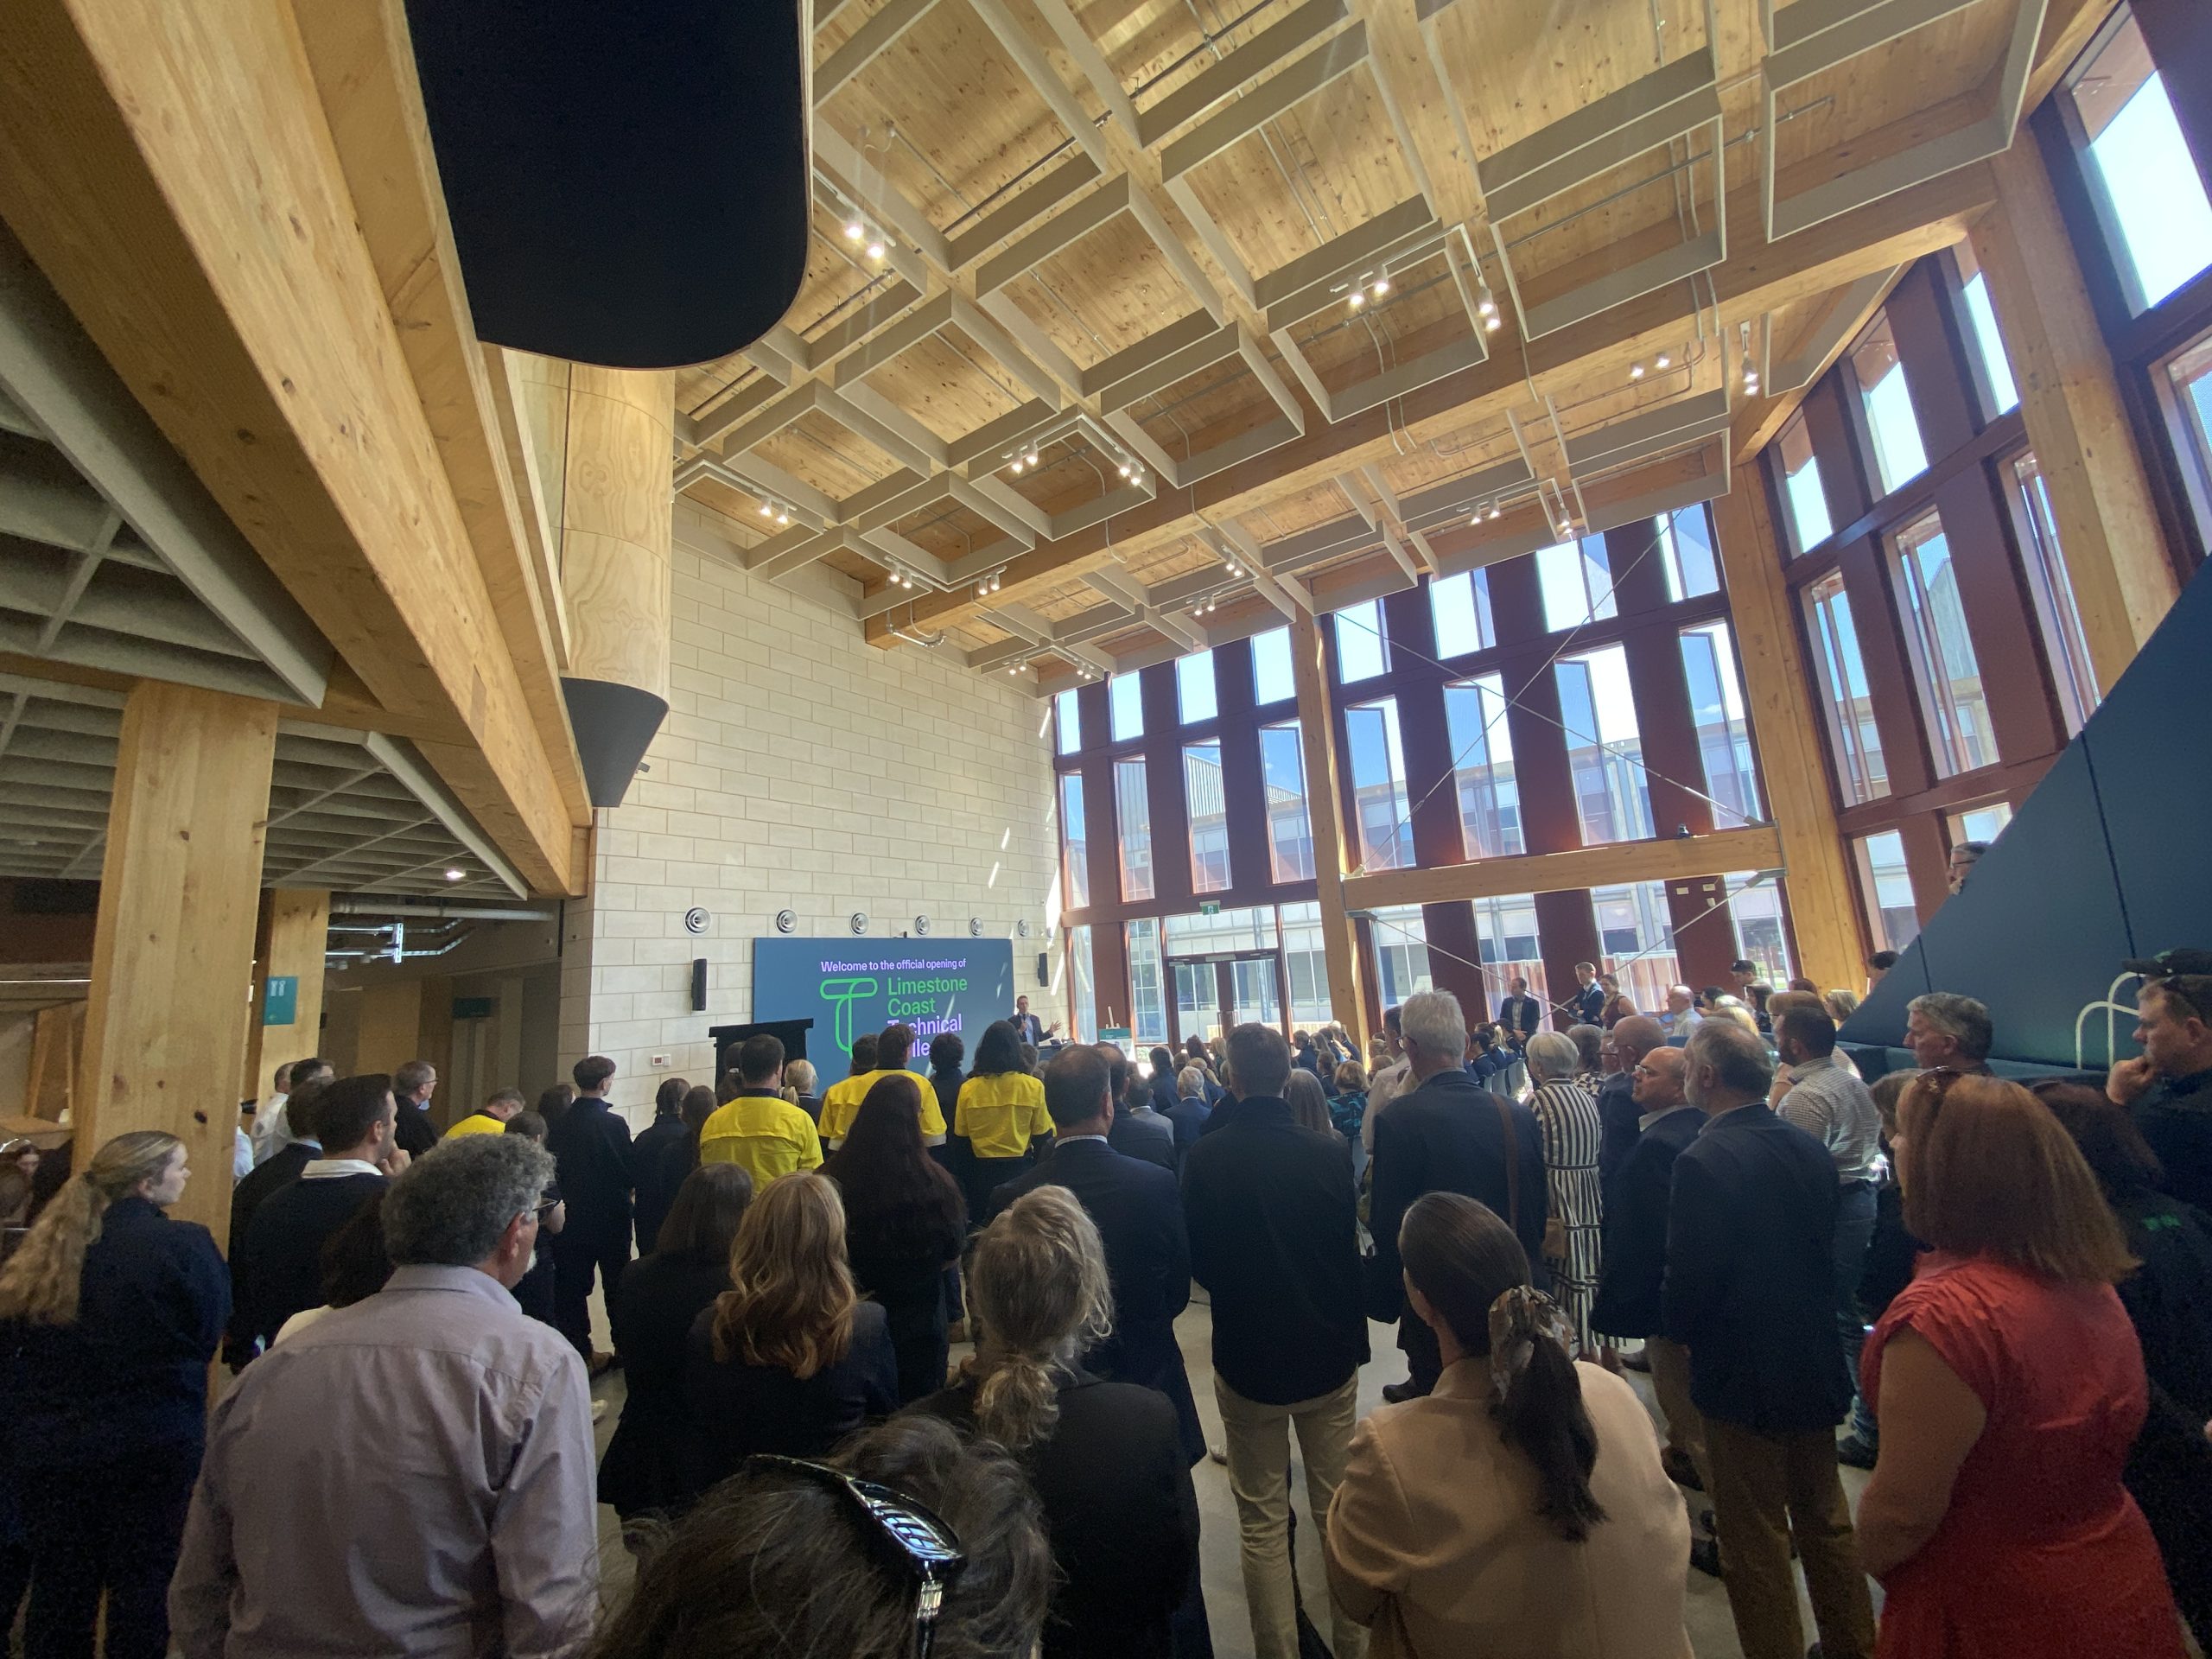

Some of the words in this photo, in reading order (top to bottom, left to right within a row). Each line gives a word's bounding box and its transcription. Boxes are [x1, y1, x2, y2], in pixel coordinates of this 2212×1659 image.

[820, 961, 867, 972] Welcome
[869, 961, 879, 970] to
[880, 959, 895, 970] the
[896, 959, 925, 969] official
[925, 958, 957, 970] opening
[958, 957, 967, 968] of
[887, 976, 968, 995] Limestone
[887, 997, 937, 1017] Coast
